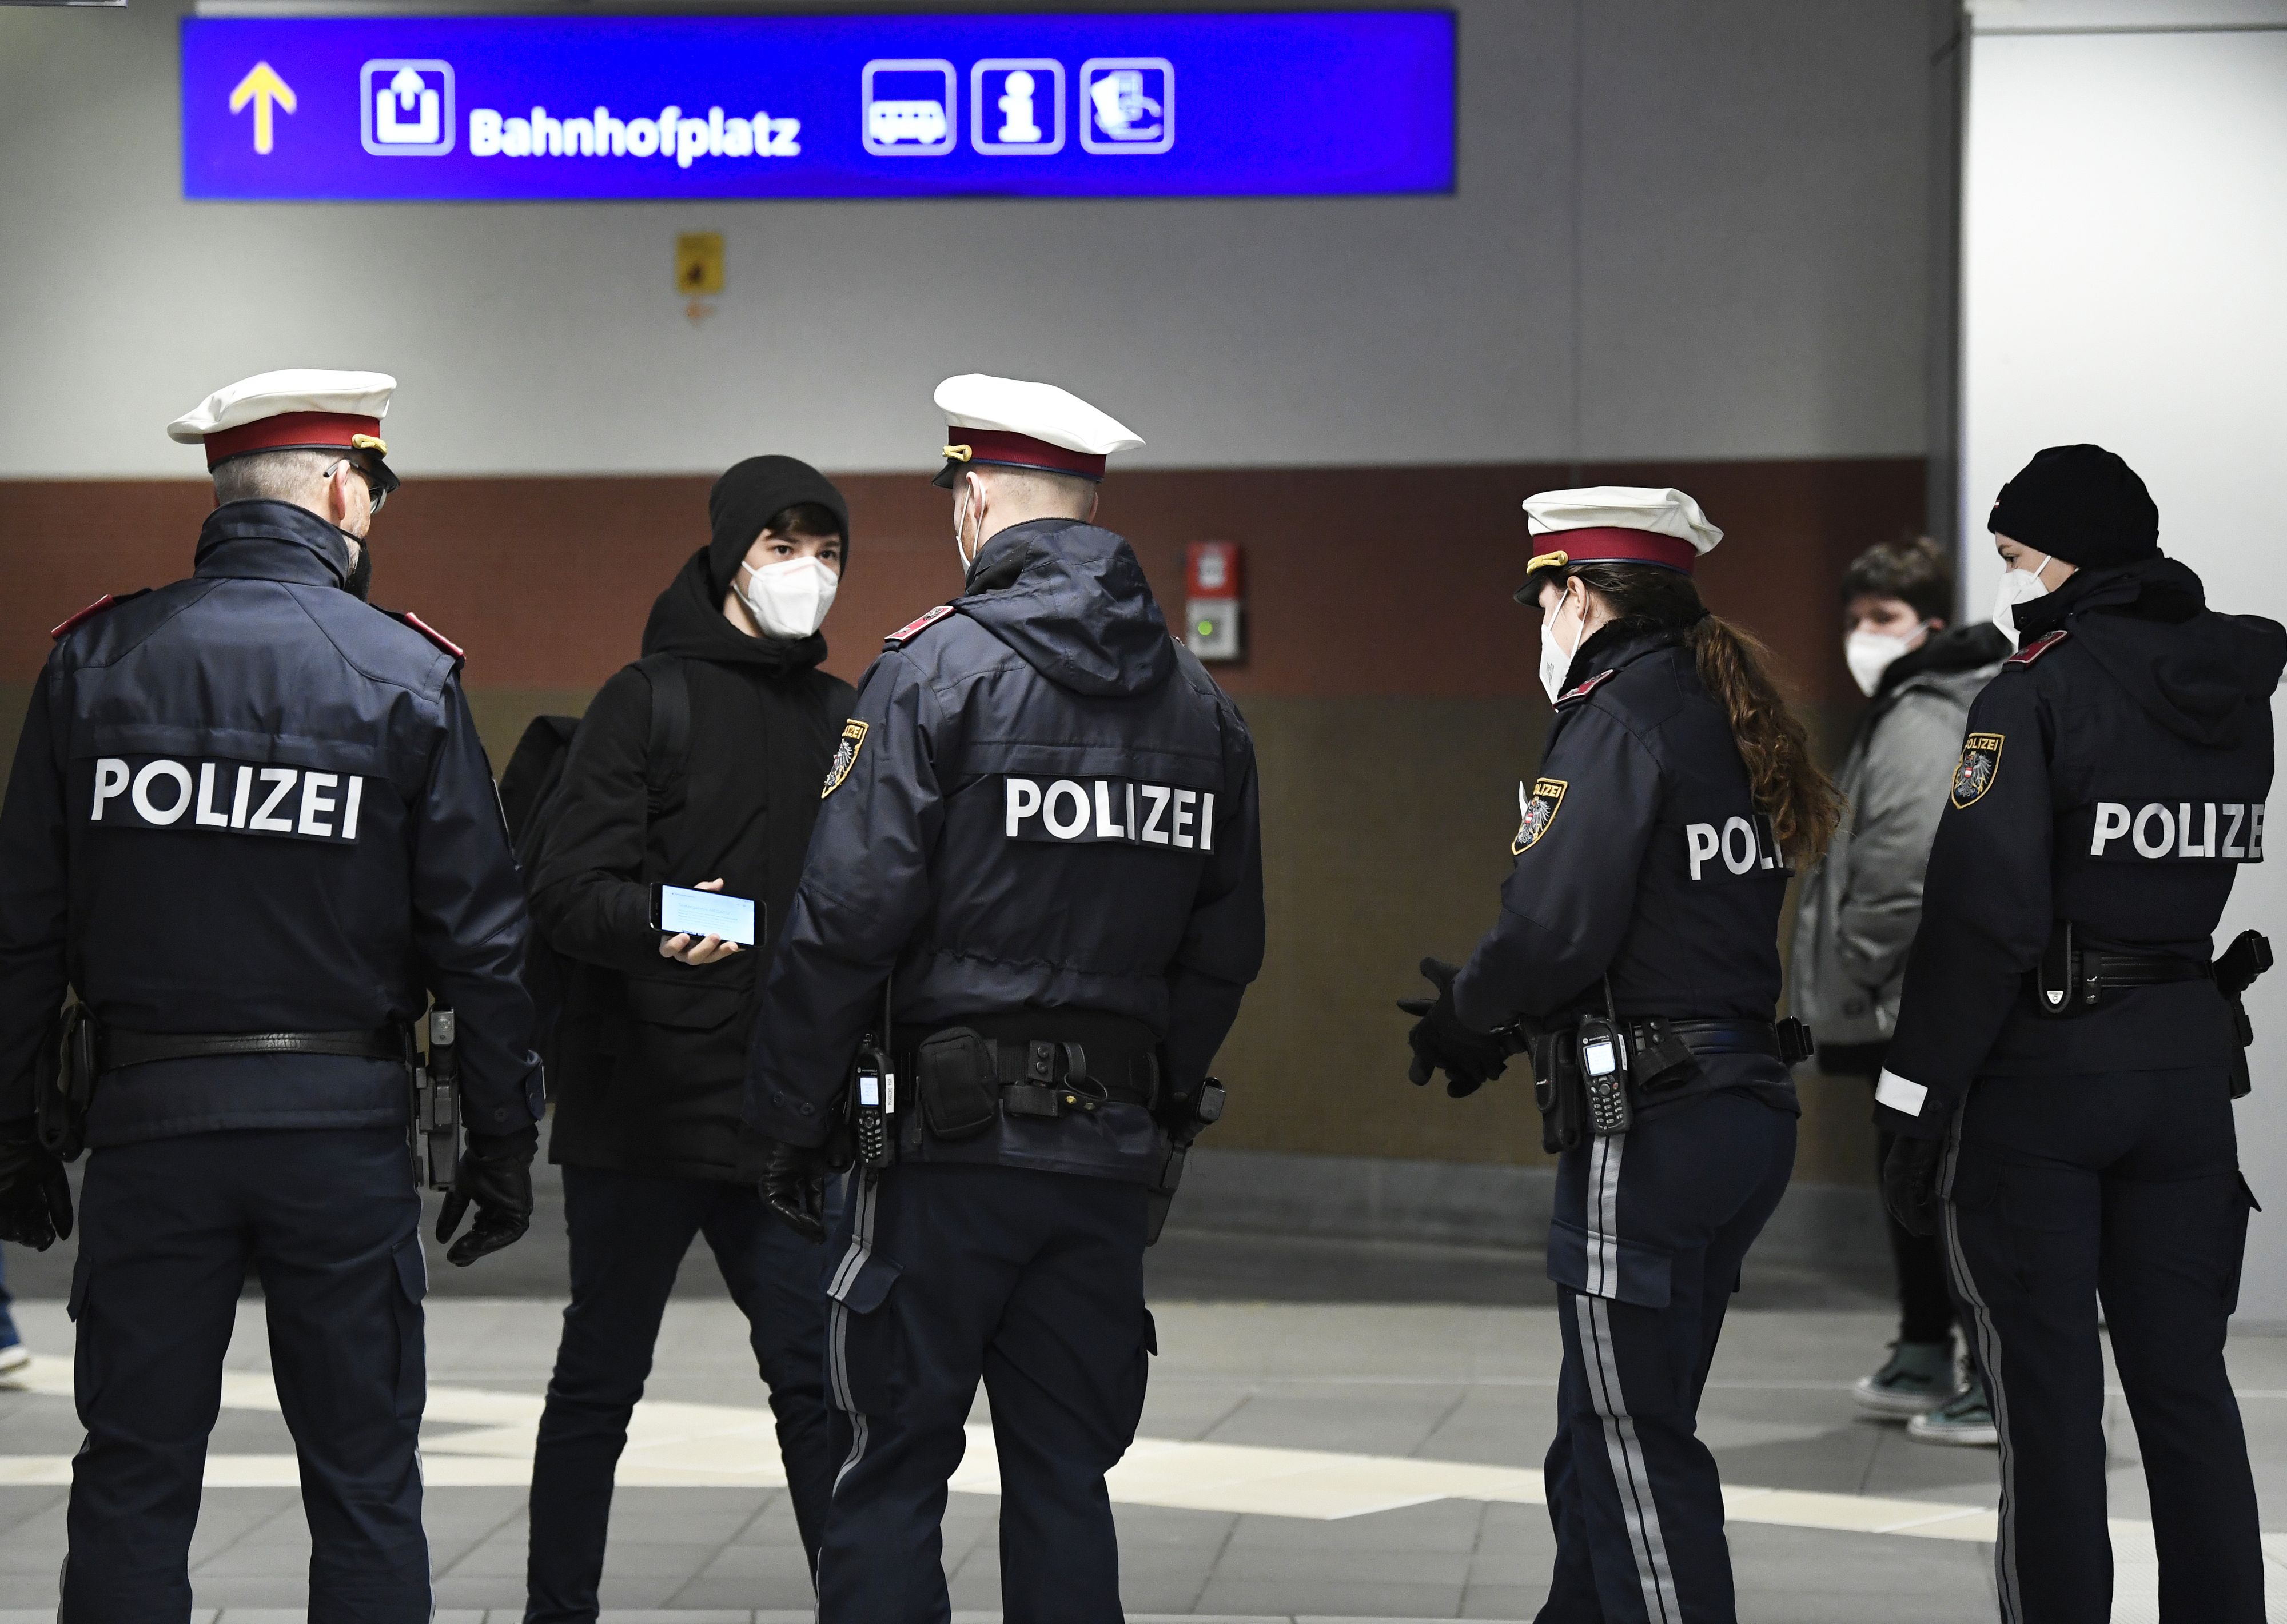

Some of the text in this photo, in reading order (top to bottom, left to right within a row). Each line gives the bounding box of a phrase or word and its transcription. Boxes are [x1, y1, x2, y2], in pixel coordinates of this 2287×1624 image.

[469, 105, 802, 169] Bahnhofplatz
[842, 725, 864, 740] LIZEI
[1966, 737, 1999, 751] OLIZEI
[91, 758, 364, 839] POLIZEI
[1006, 778, 1215, 851] POLIZEI
[1533, 784, 1562, 799] OLIZEI
[1686, 815, 1794, 881] POLI
